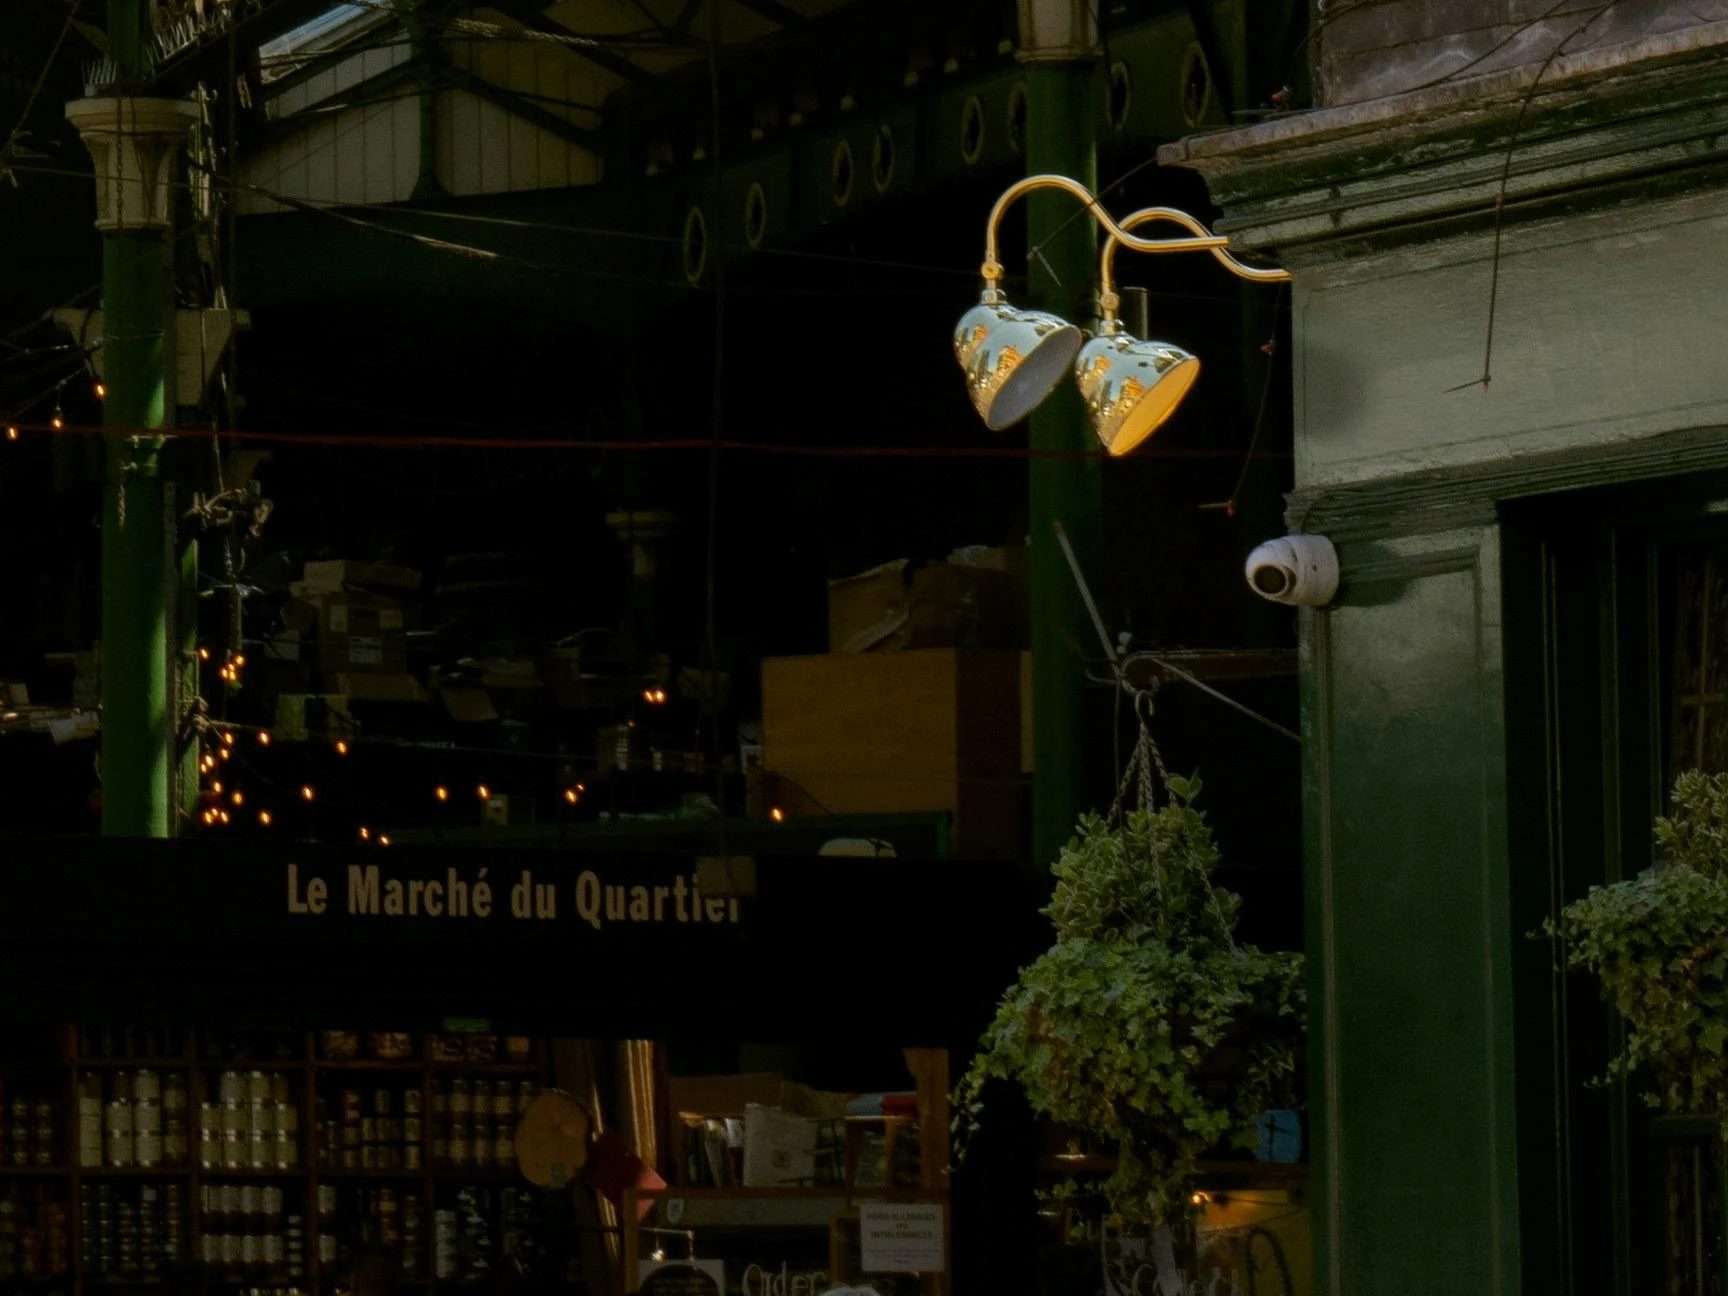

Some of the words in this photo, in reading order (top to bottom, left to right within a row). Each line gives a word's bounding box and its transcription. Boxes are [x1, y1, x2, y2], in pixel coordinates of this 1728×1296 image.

[286, 863, 328, 915] Le
[347, 864, 493, 918] Marché
[510, 869, 557, 920] du
[574, 869, 740, 930] Quartier
